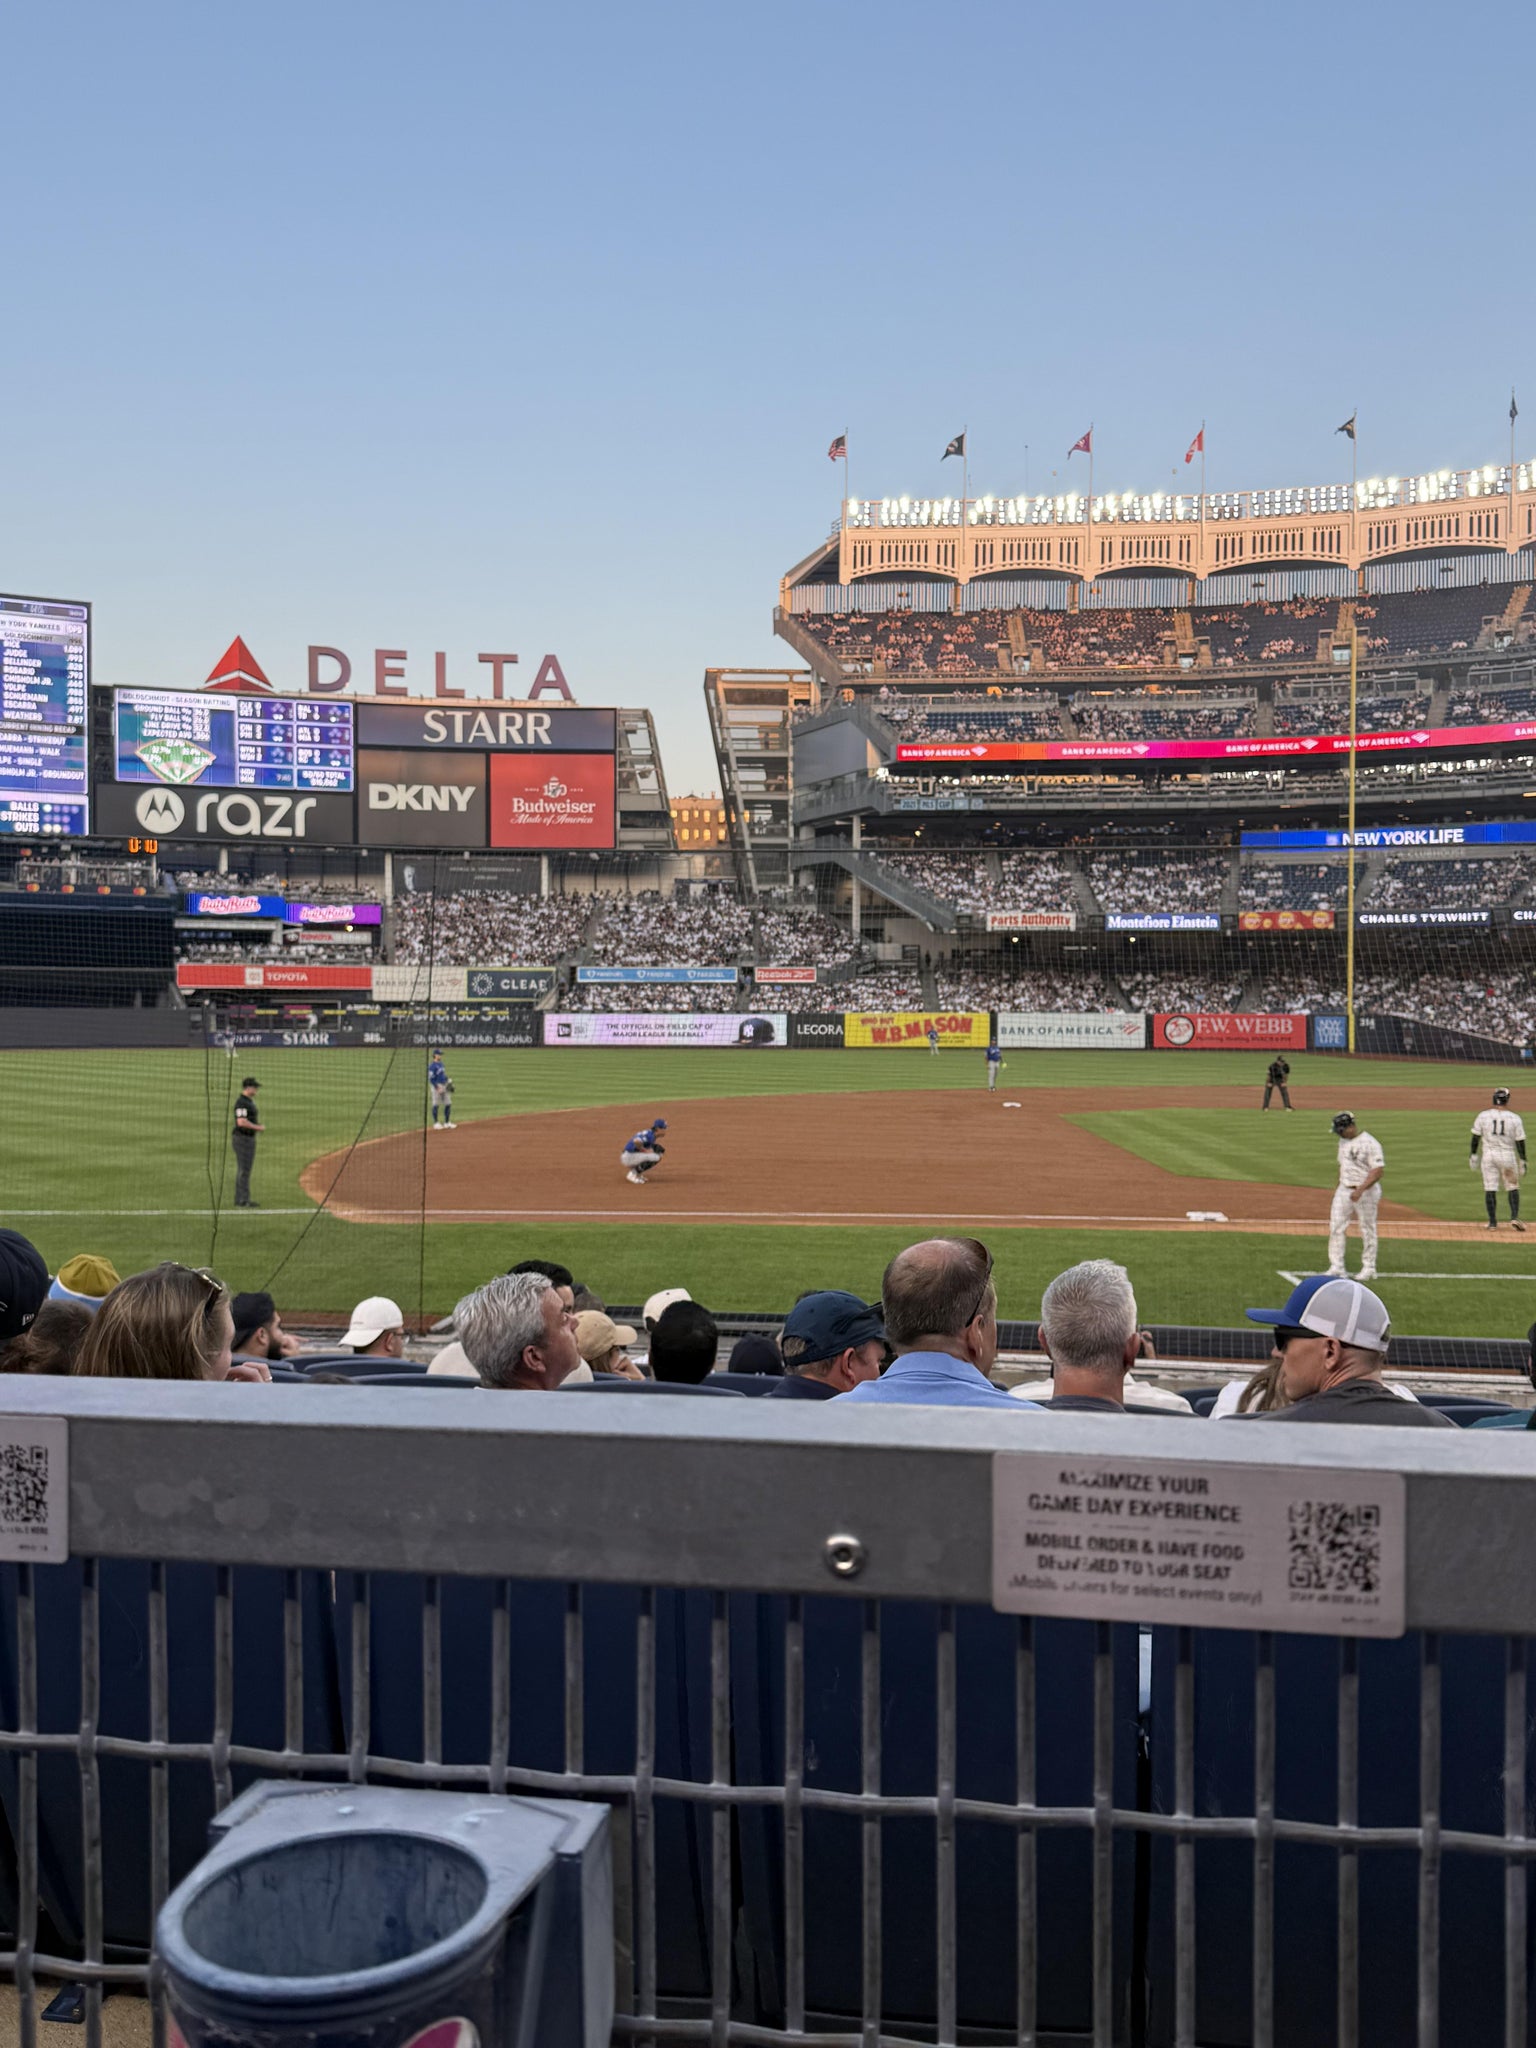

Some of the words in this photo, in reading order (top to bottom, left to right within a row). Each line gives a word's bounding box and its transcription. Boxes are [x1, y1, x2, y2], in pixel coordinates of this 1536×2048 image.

[8, 620, 28, 628] YORK
[30, 622, 61, 631] YANKEES
[308, 645, 573, 700] DELTA
[3, 673, 41, 685] CHISHOLM
[3, 682, 27, 692] VOLPE
[3, 691, 49, 703] SCHUEMANN
[163, 705, 181, 714] BALL
[163, 714, 181, 722] BALL
[142, 728, 178, 738] EXPECTED
[423, 709, 552, 745] STARR
[27, 734, 67, 746] STRIKEOUT
[1358, 739, 1372, 748] OF
[1371, 737, 1411, 747] AMERICA
[39, 747, 60, 757] WALK
[936, 748, 971, 757] AMERICA
[1062, 748, 1085, 756] BANK
[1085, 747, 1096, 755] OF
[1095, 746, 1132, 756] AMERICA
[1225, 744, 1250, 753] BANK
[1249, 743, 1263, 752] OF
[1262, 742, 1300, 752] AMERICA
[17, 756, 43, 767] SINGLE
[42, 769, 85, 781] GROUNDOUT
[368, 783, 475, 812] DKNY
[10, 801, 40, 812] BALLS
[511, 797, 596, 813] Budweiser
[0, 810, 40, 823] STRIKES
[196, 793, 317, 837] razr
[510, 814, 541, 824] Made
[543, 814, 554, 826] of
[552, 814, 594, 824] America
[14, 822, 40, 833] OUTS
[1342, 833, 1382, 846] NEW
[1381, 831, 1430, 845] YORK
[1429, 828, 1465, 844] LIFE
[991, 914, 1019, 926] Parts
[1021, 914, 1071, 926] Authority
[1108, 914, 1170, 928] Montefiore
[1171, 915, 1218, 928] Einstein
[1359, 914, 1417, 924] CHARLES
[1421, 912, 1490, 923] TYRWHITT
[266, 972, 309, 982] TOYOTA
[757, 969, 792, 979] Reebok
[879, 1016, 895, 1025] BUT
[1197, 1018, 1231, 1034] F.W.
[1234, 1018, 1294, 1034] WEBB
[796, 1024, 843, 1036] LEGORA
[1000, 1026, 1034, 1036] BANK
[1037, 1026, 1052, 1036] OF
[1056, 1026, 1114, 1036] AMERICA
[282, 1031, 330, 1045] STARR
[1319, 1035, 1341, 1044] LIFE
[1492, 1119, 1506, 1136] 11
[1028, 1493, 1082, 1513] GAME
[1087, 1496, 1124, 1516] DAY
[1129, 1499, 1242, 1523] EXPERIENCE
[1025, 1532, 1082, 1550] MOBILE
[1087, 1535, 1138, 1553] ORDER
[1141, 1538, 1154, 1554] &
[1157, 1540, 1198, 1558] HAVE
[1202, 1543, 1245, 1561] FOOD
[1193, 1563, 1232, 1580] SEAT
[1111, 1580, 1130, 1595] for
[1134, 1582, 1177, 1598] select
[1179, 1586, 1225, 1602] events
